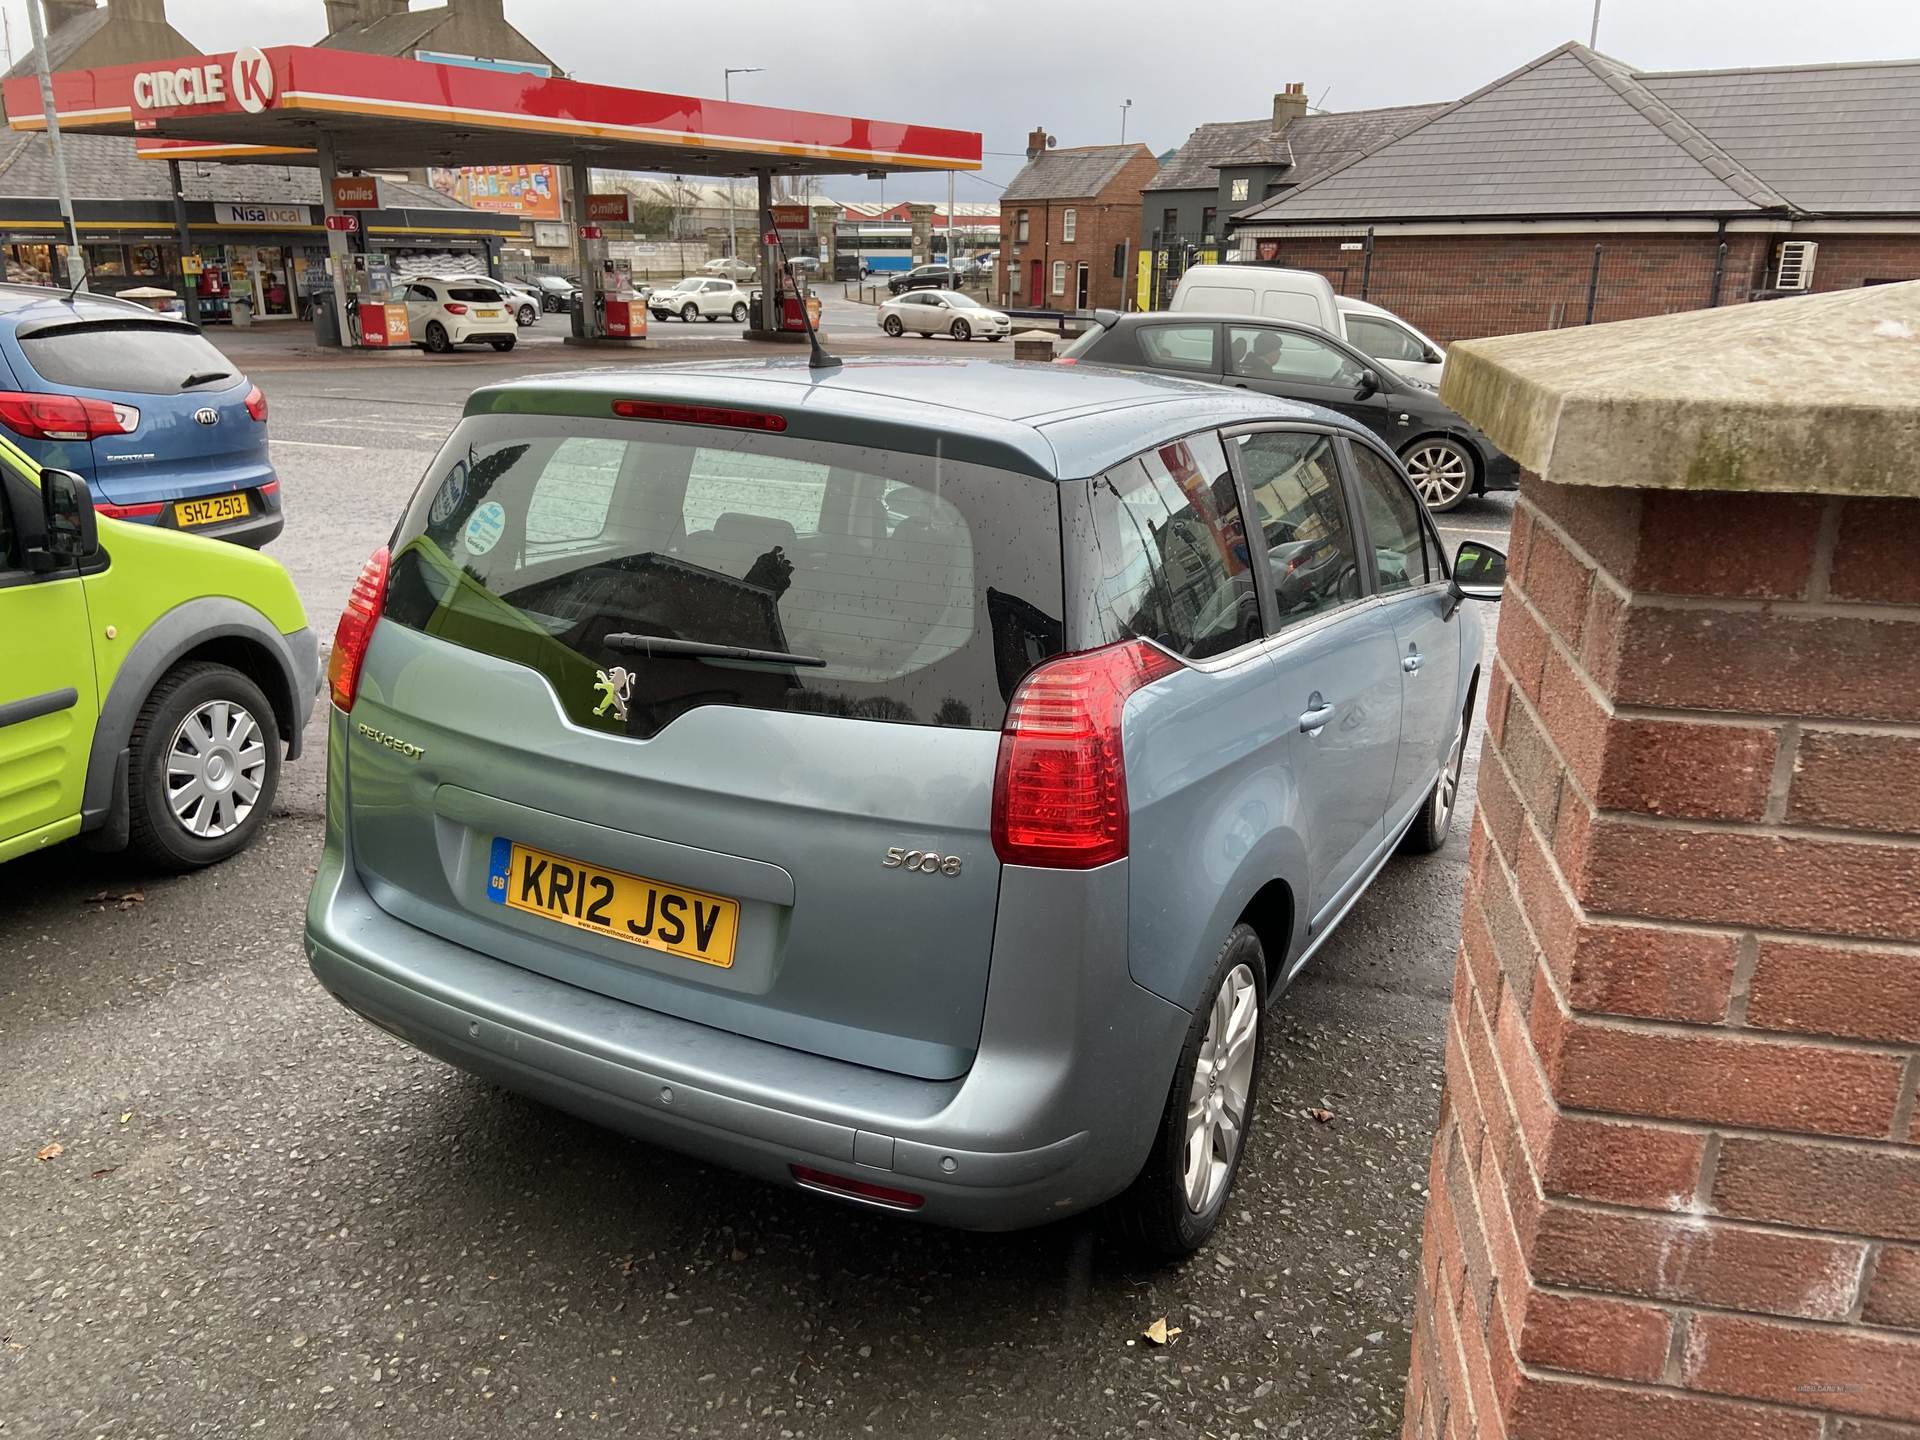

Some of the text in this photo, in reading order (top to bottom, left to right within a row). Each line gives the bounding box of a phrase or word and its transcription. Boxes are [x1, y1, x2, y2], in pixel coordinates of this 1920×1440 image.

[133, 58, 269, 109] CIRCLE K
[328, 218, 355, 229] 1 2
[580, 228, 586, 238] 3
[199, 411, 217, 423] KIA
[184, 496, 243, 523] SHZ 2513
[358, 722, 426, 761] PEUGEOT
[882, 847, 962, 877] 5008
[492, 875, 505, 890] GB
[520, 855, 721, 954] KR12 JSV
